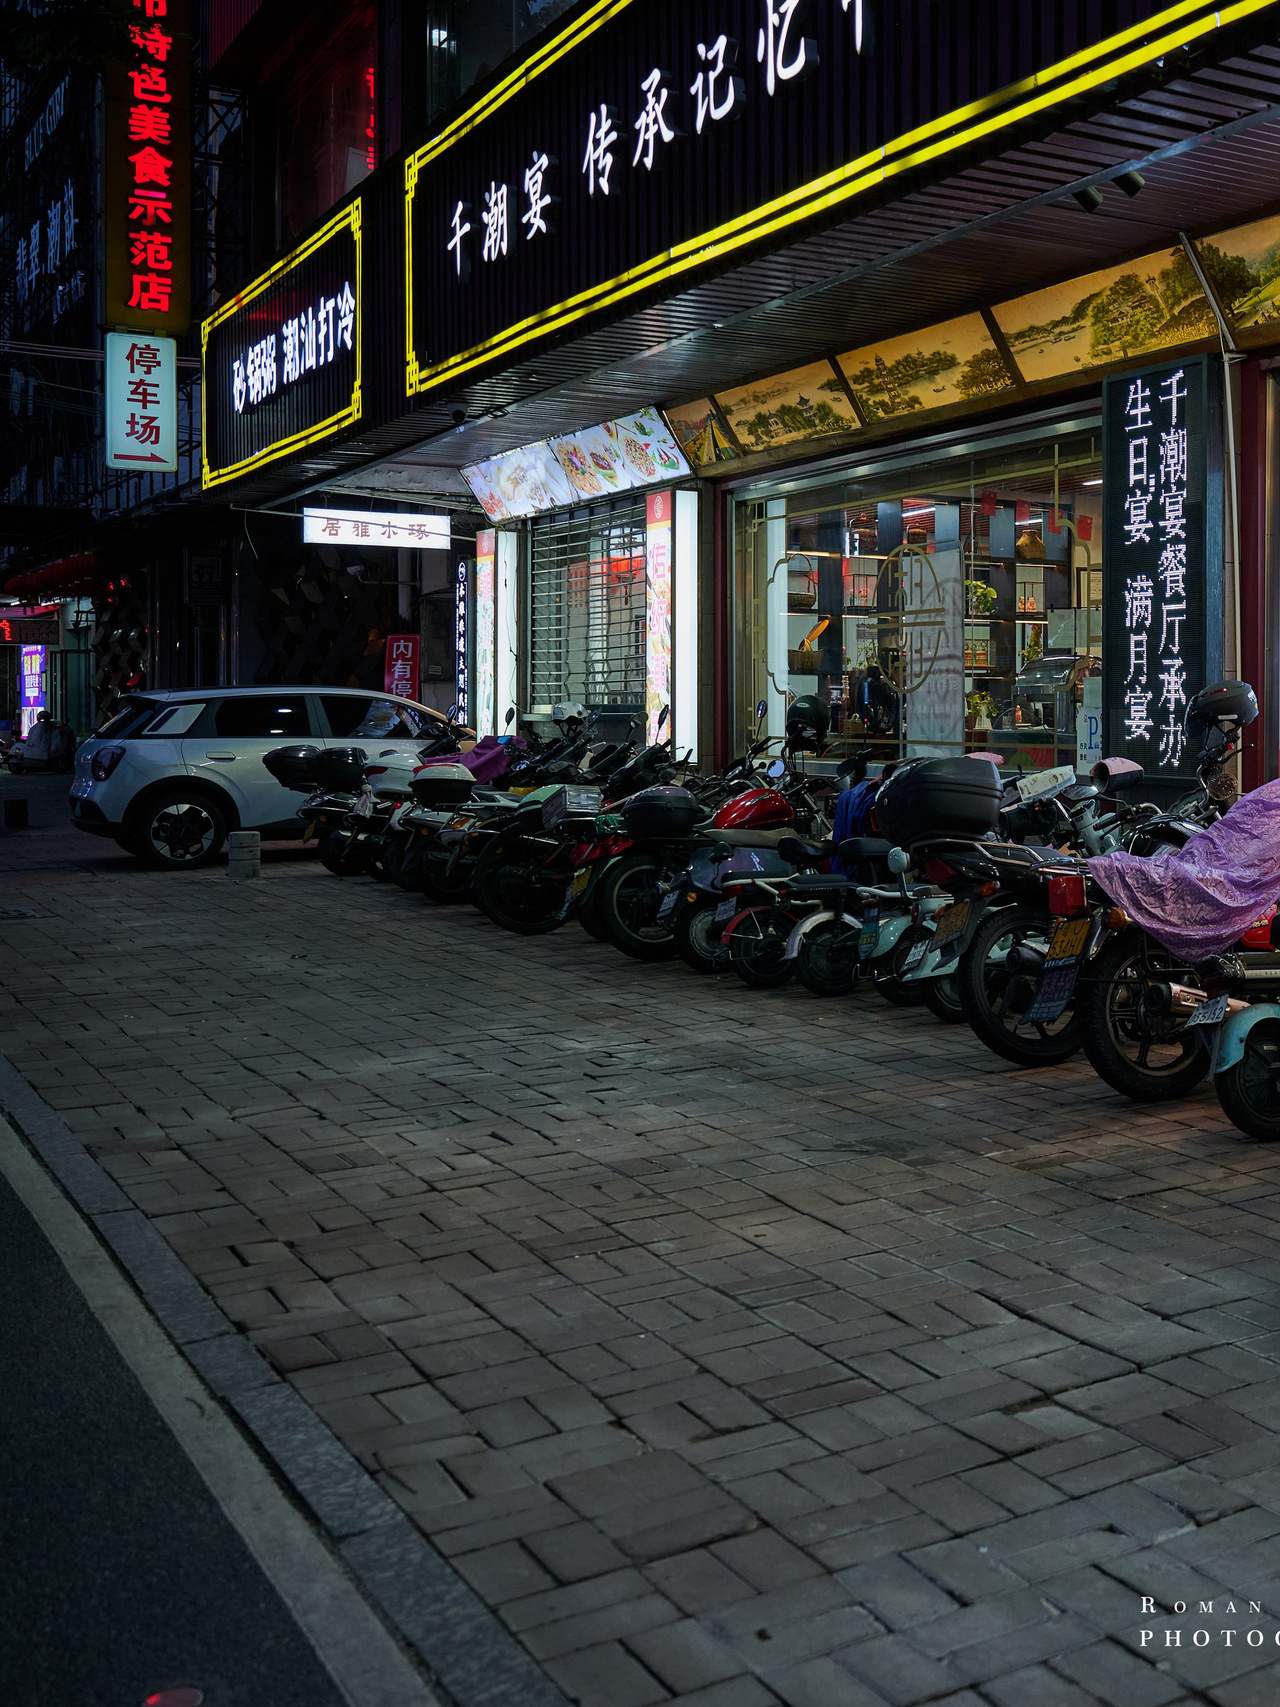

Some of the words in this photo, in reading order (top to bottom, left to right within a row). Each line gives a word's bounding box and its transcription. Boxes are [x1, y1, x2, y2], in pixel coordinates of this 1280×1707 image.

[447, 151, 553, 279] 千潮宴
[582, 0, 863, 196] 传承记忆
[126, 343, 161, 446] 停车场
[233, 334, 276, 414] 砂锅粥
[281, 280, 356, 385] 潮汕打冷
[1124, 379, 1154, 545] 生日宴
[1158, 369, 1187, 767] 千潮宴餐厅承办
[1124, 574, 1154, 741] 满月宴
